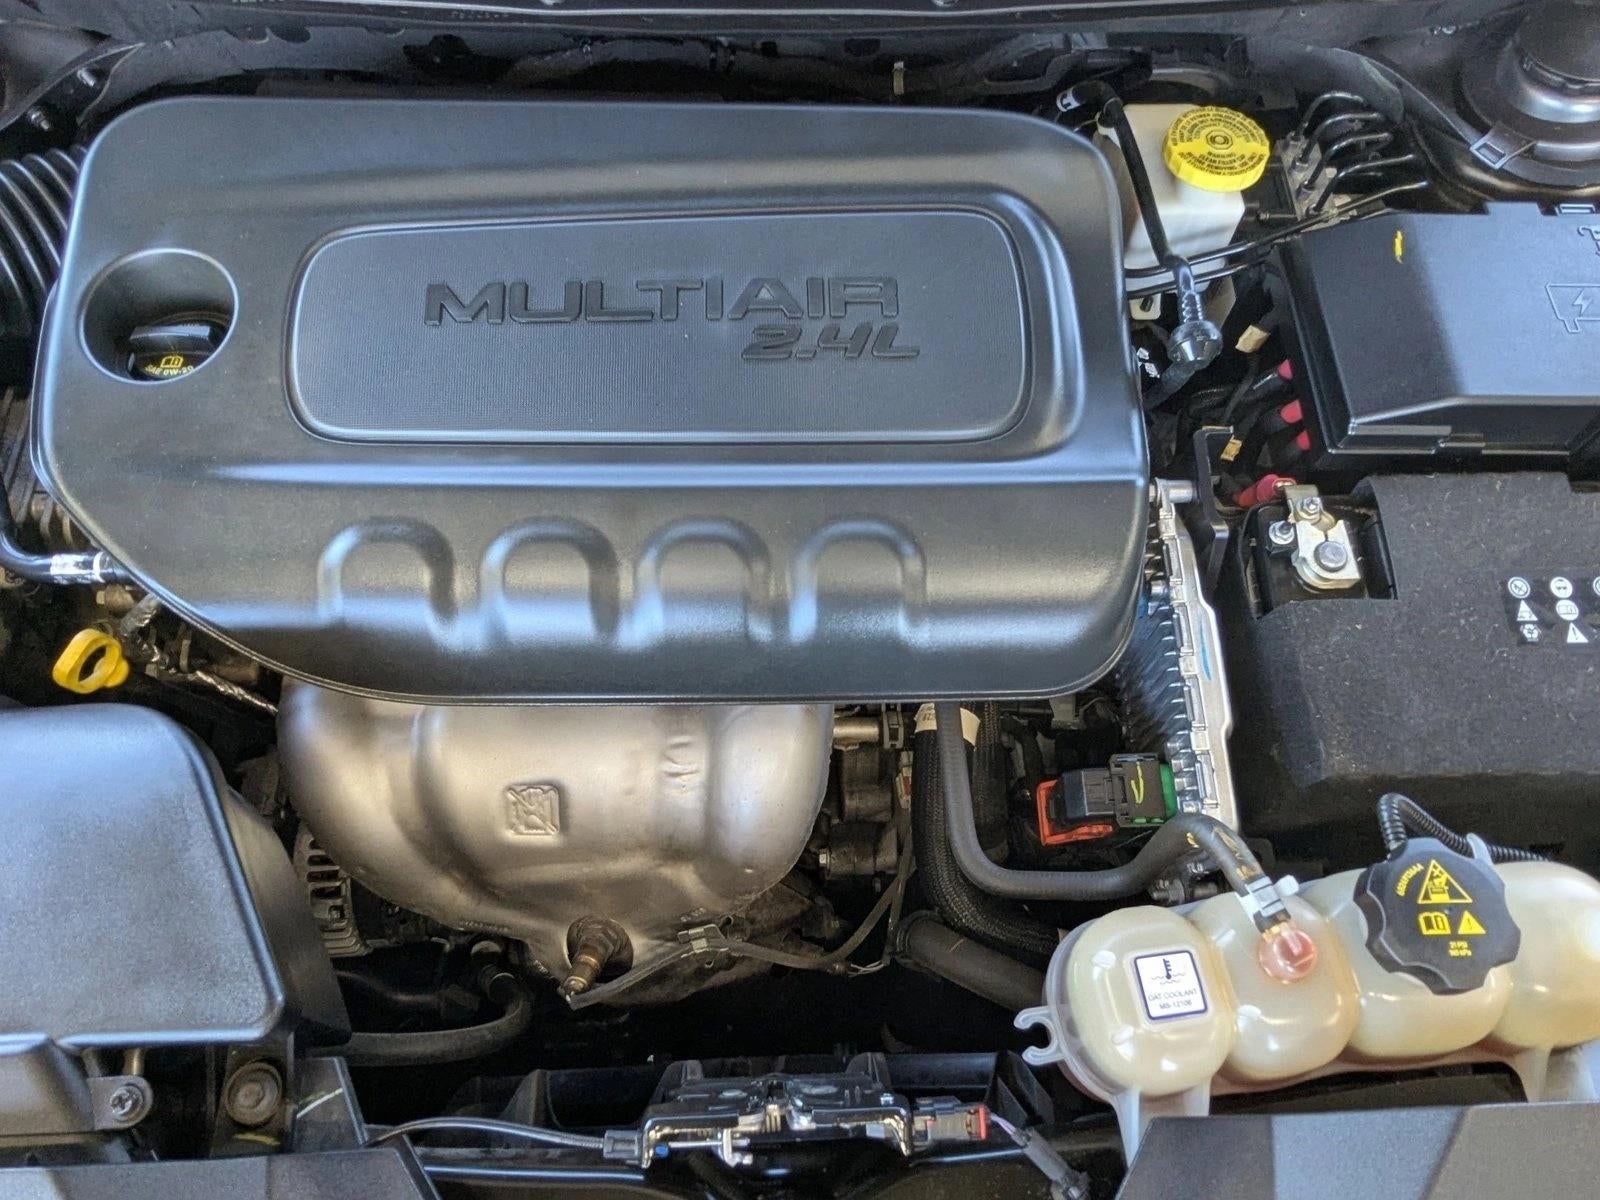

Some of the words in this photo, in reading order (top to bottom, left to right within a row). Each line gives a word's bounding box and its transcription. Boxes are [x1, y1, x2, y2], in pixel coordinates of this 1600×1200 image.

[423, 276, 900, 327] MULTIAIR
[740, 322, 921, 361] 2.4L
[1162, 988, 1197, 999] COOLANT
